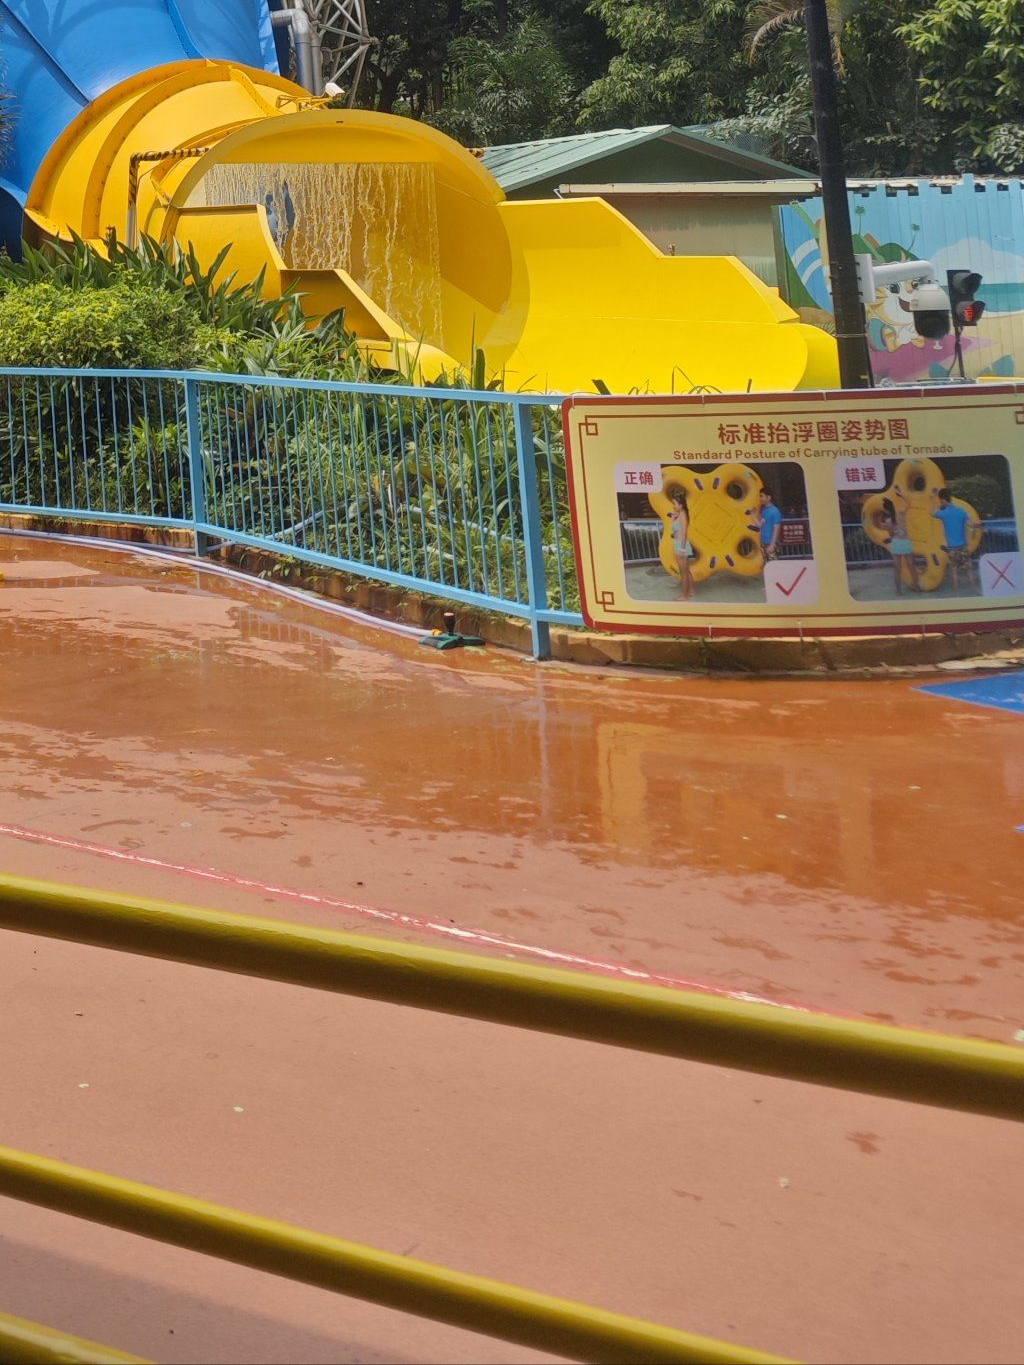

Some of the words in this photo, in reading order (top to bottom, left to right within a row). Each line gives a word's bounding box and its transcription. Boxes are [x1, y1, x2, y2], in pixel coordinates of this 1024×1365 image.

[717, 418, 910, 446] 标准抬浮圈姿势图
[673, 450, 732, 460] Standard
[735, 449, 785, 459] Posture
[789, 447, 801, 457] of
[803, 446, 858, 458] Carrying
[860, 446, 887, 455] tube
[890, 445, 902, 455] of
[904, 444, 953, 454] Tornado
[624, 471, 654, 485] 正确
[844, 467, 877, 483] 错误
